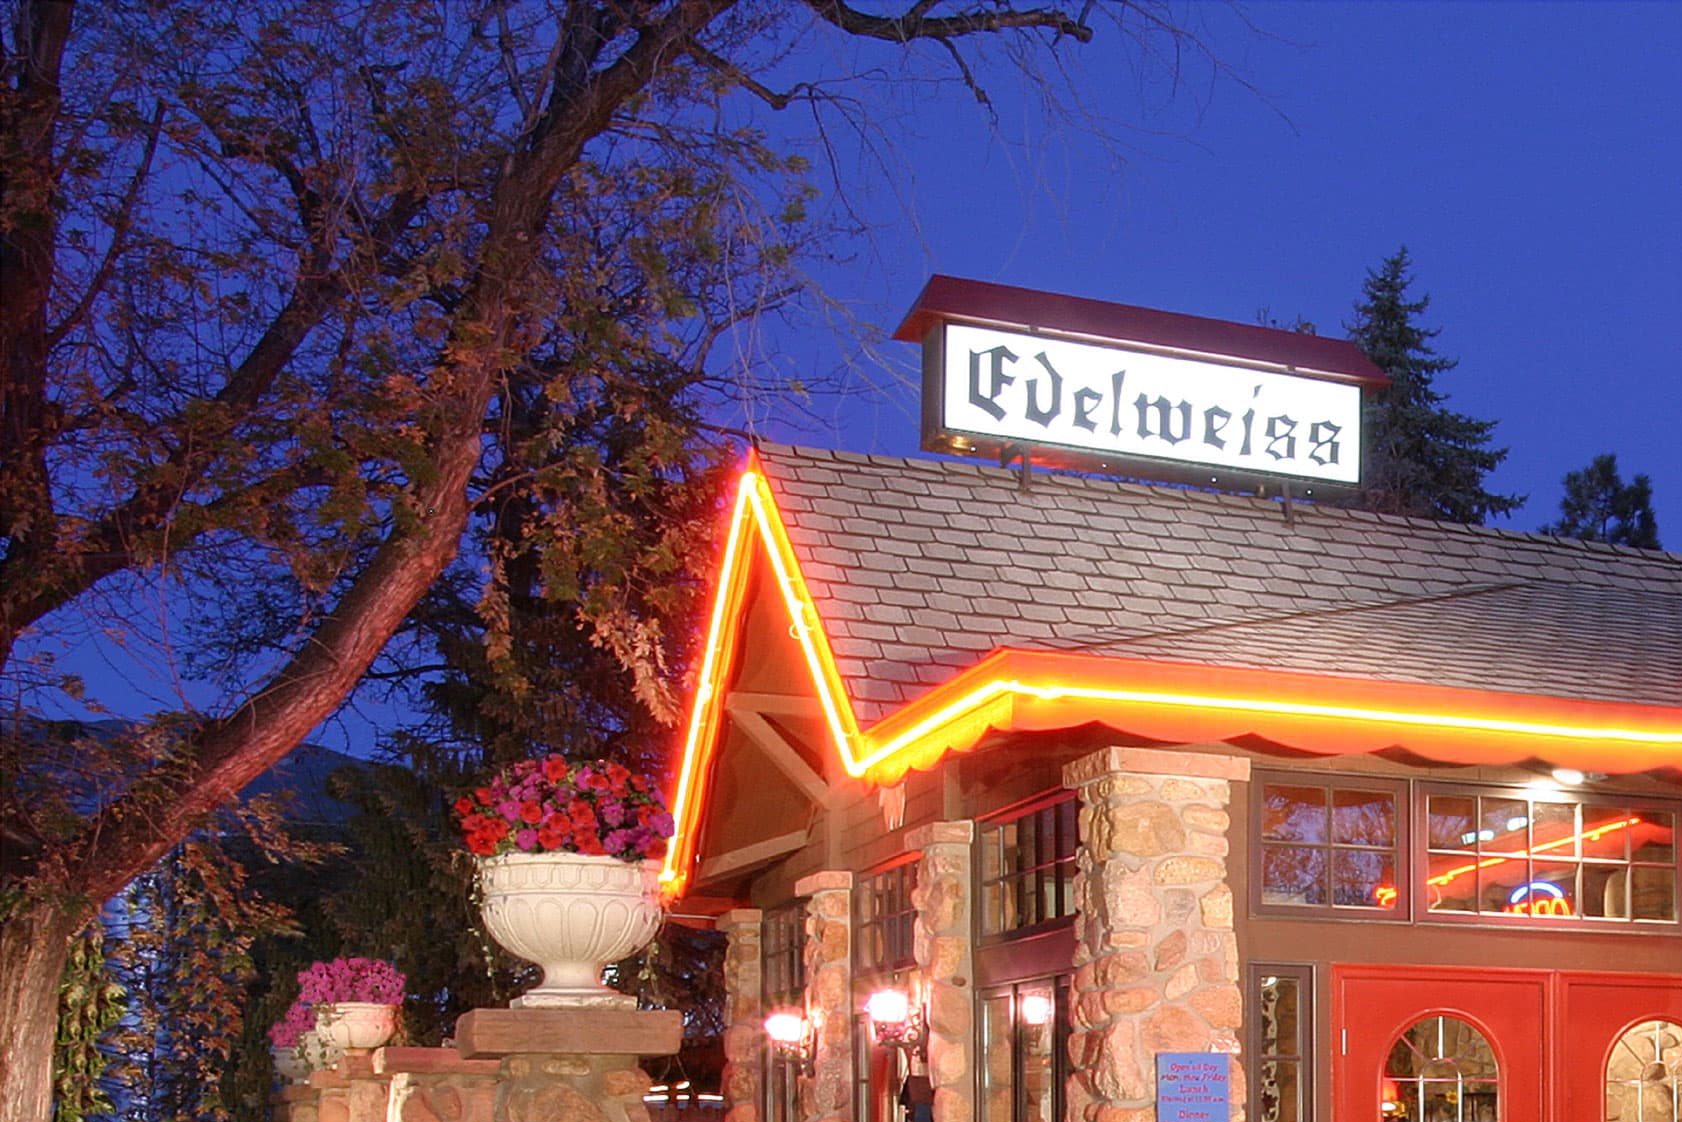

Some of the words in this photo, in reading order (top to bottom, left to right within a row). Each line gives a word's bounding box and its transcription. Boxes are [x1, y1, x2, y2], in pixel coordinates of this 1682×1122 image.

[968, 344, 1343, 467] Edelweiss
[1170, 1063, 1189, 1072] Open
[1203, 1063, 1217, 1072] Day
[1179, 1084, 1208, 1093] Lunch
[1178, 1110, 1209, 1119] Dinner
